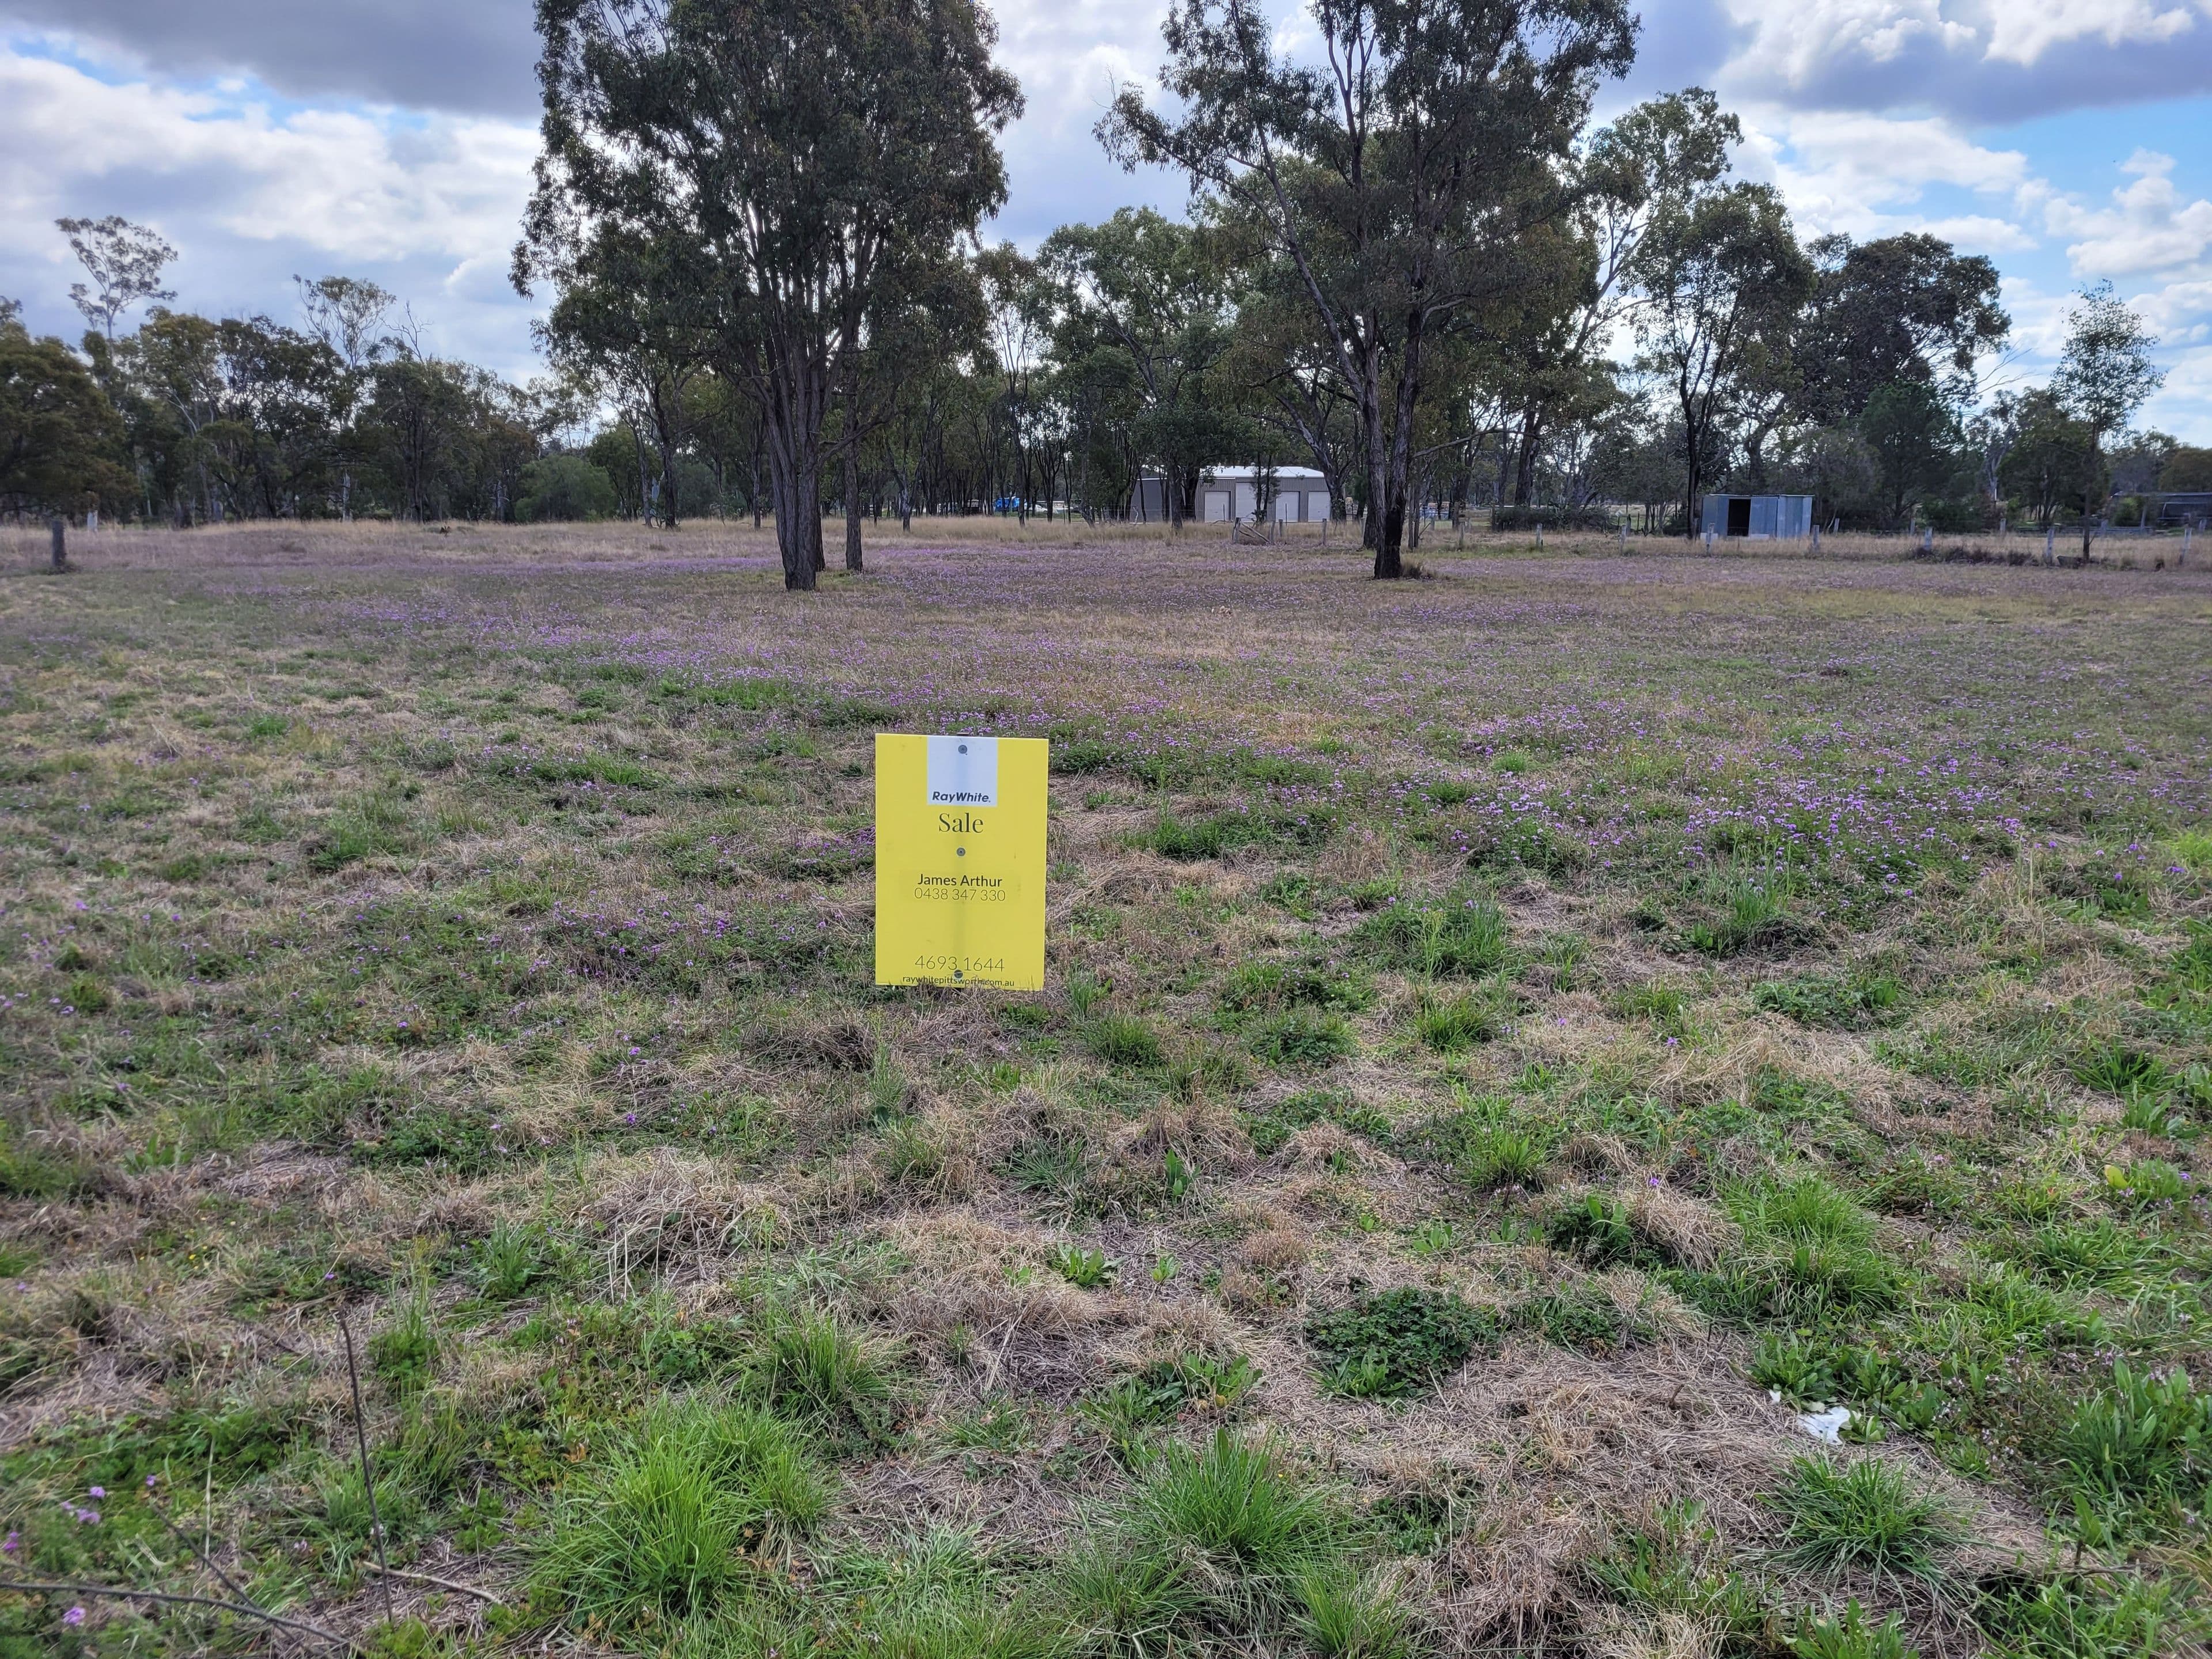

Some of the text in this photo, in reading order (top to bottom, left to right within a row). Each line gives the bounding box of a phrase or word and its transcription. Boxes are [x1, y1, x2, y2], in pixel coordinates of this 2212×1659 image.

[938, 812, 984, 834] Sale
[917, 873, 1003, 887] James Arthur
[914, 887, 1006, 902] 0438 347 330
[915, 955, 1005, 972] 4693 1644
